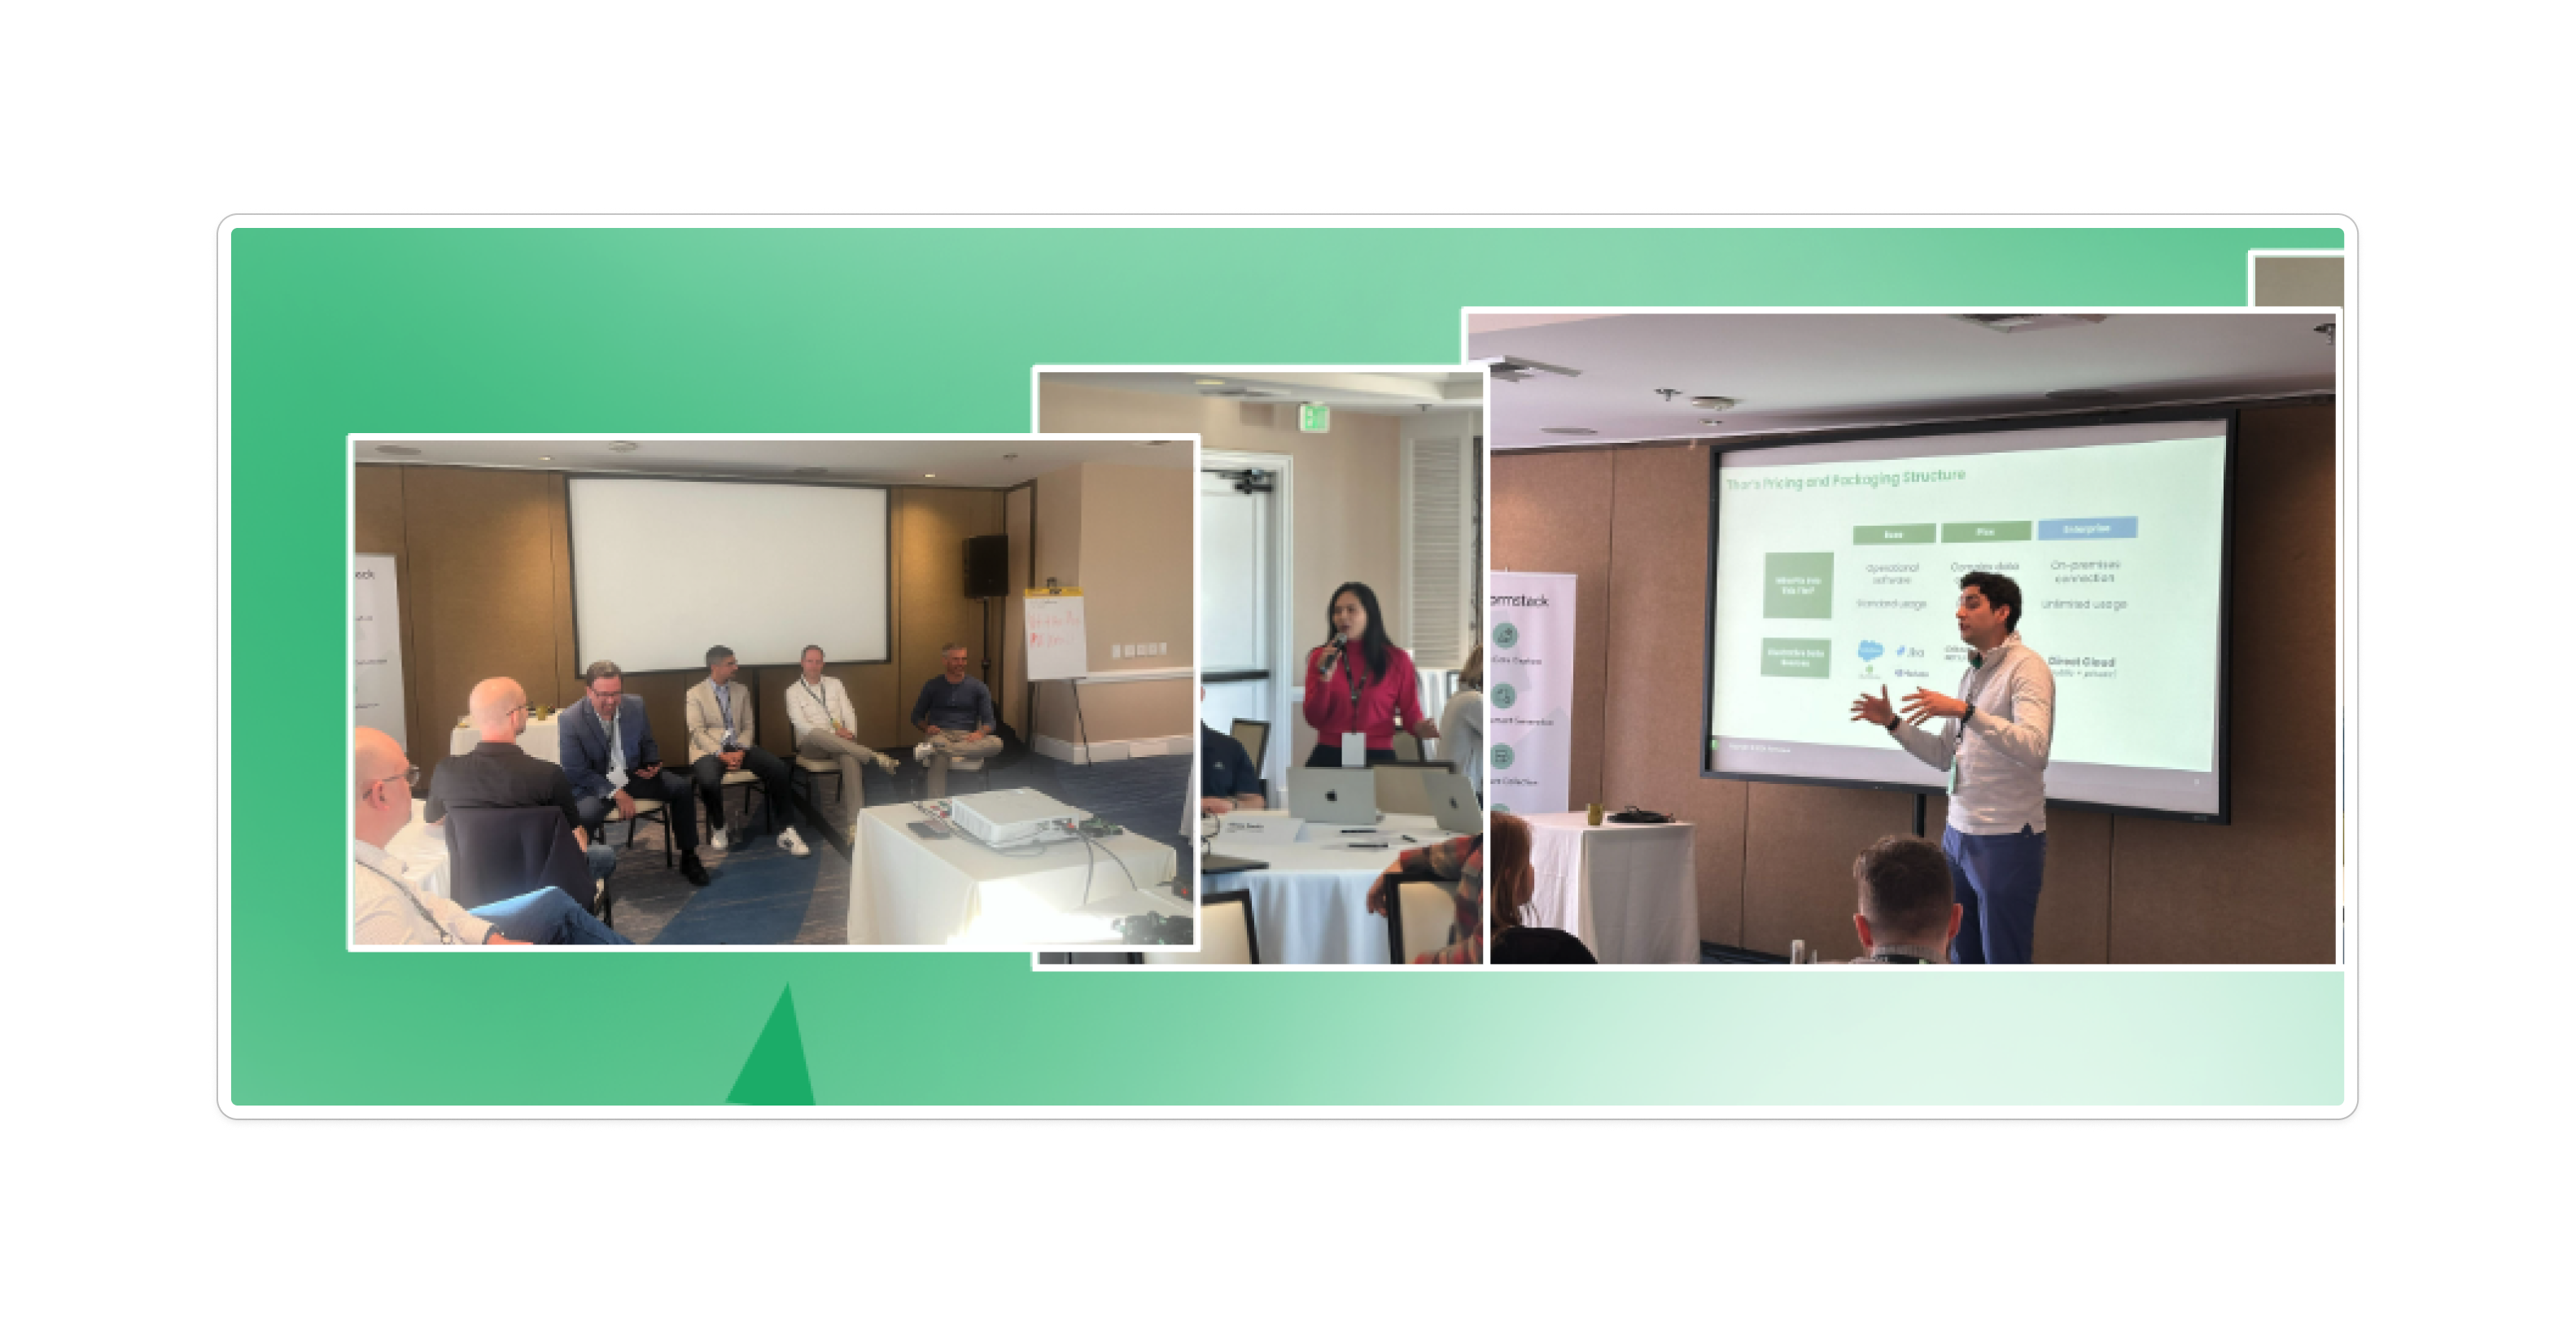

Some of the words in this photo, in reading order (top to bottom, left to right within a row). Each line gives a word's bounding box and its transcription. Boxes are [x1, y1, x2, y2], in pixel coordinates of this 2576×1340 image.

[1763, 476, 1803, 492] Pricing
[1806, 474, 1830, 488] and
[1833, 472, 1900, 489] Packaging
[1902, 469, 1966, 483] Structure
